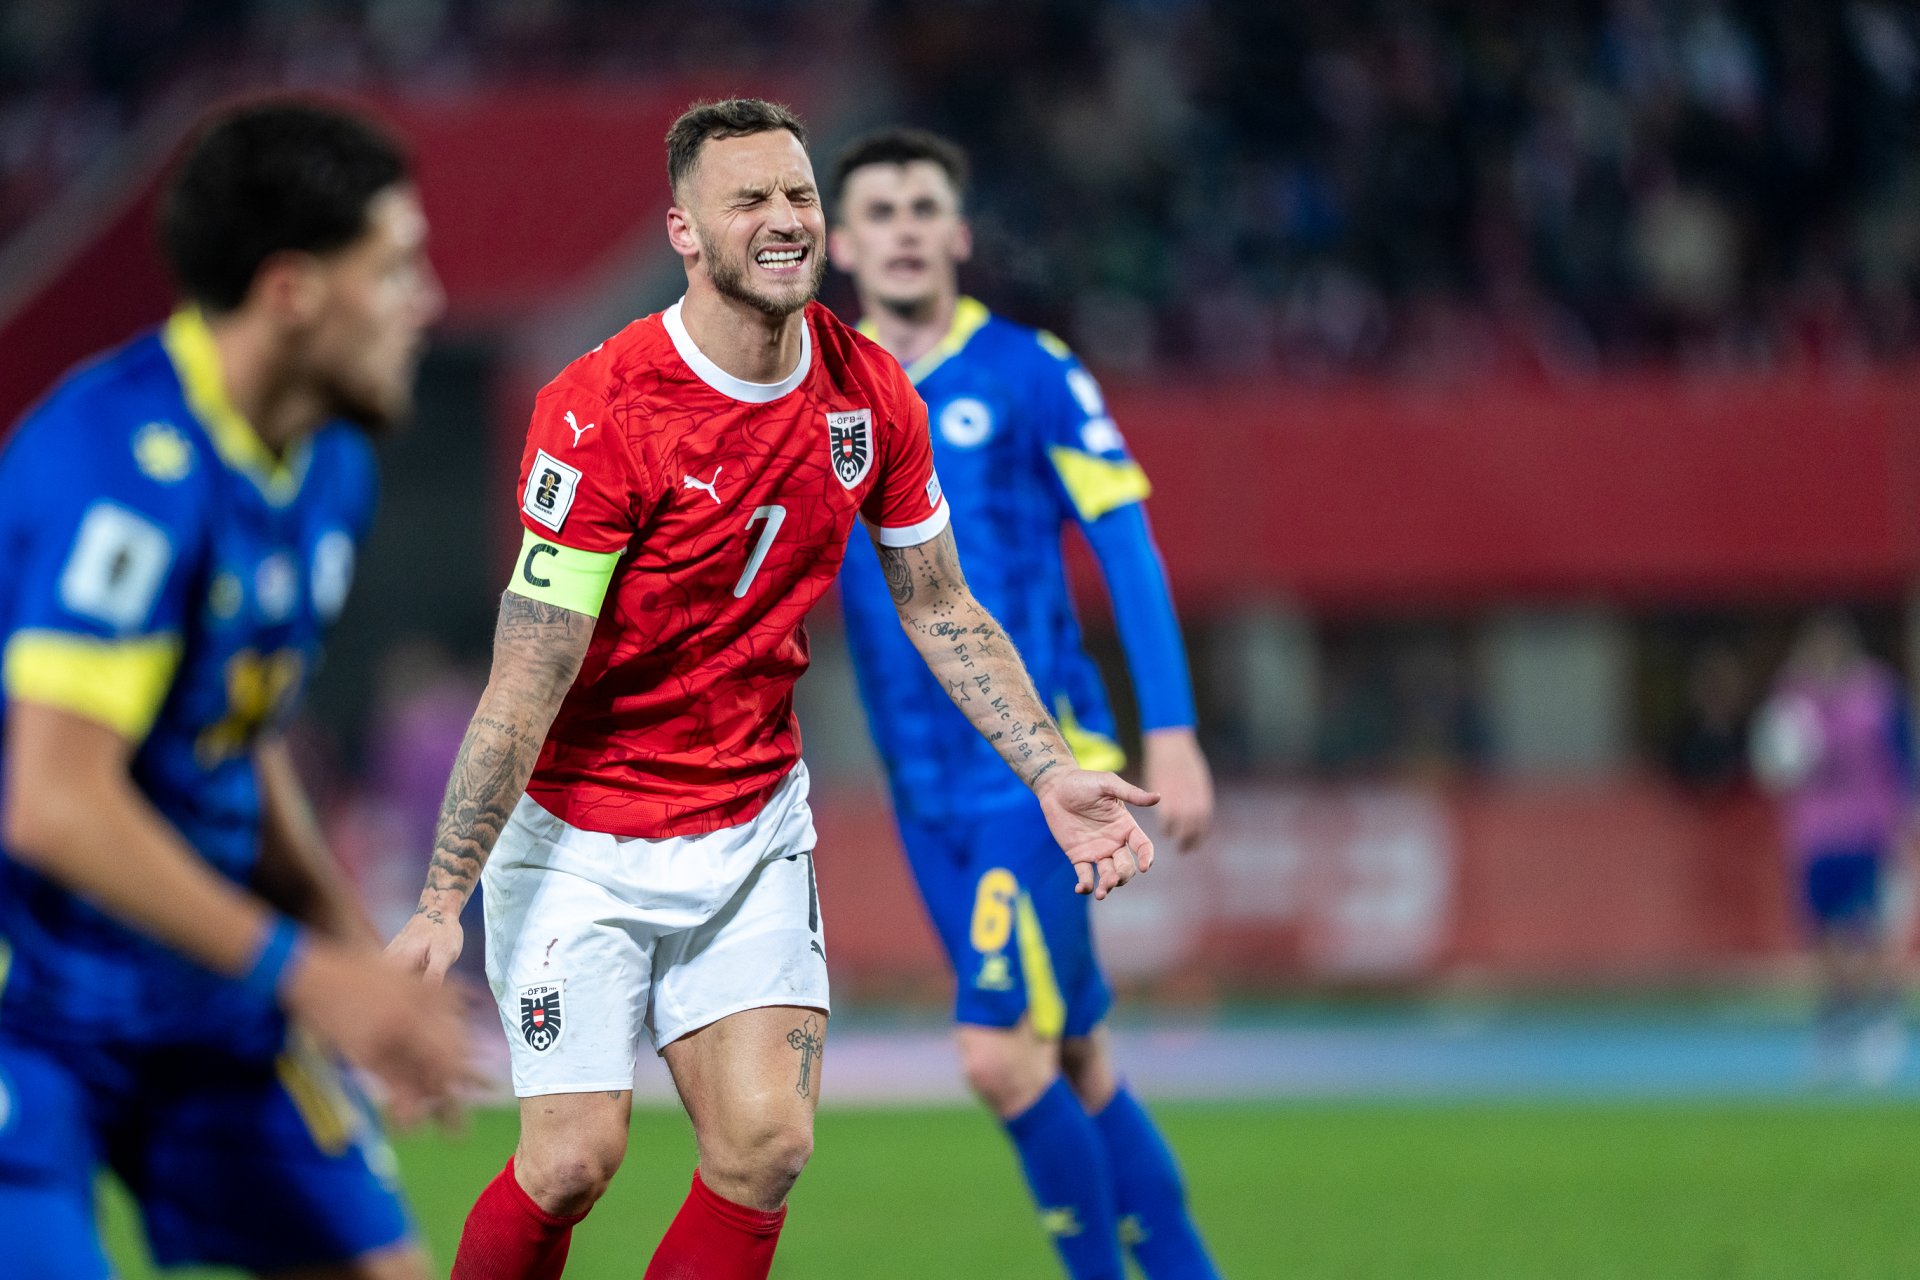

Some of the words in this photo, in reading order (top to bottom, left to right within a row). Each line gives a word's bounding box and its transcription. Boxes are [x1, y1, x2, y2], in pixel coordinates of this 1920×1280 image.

[524, 543, 559, 588] C
[733, 505, 787, 598] 7
[971, 867, 1018, 952] 6
[528, 987, 548, 996] ÖFB
